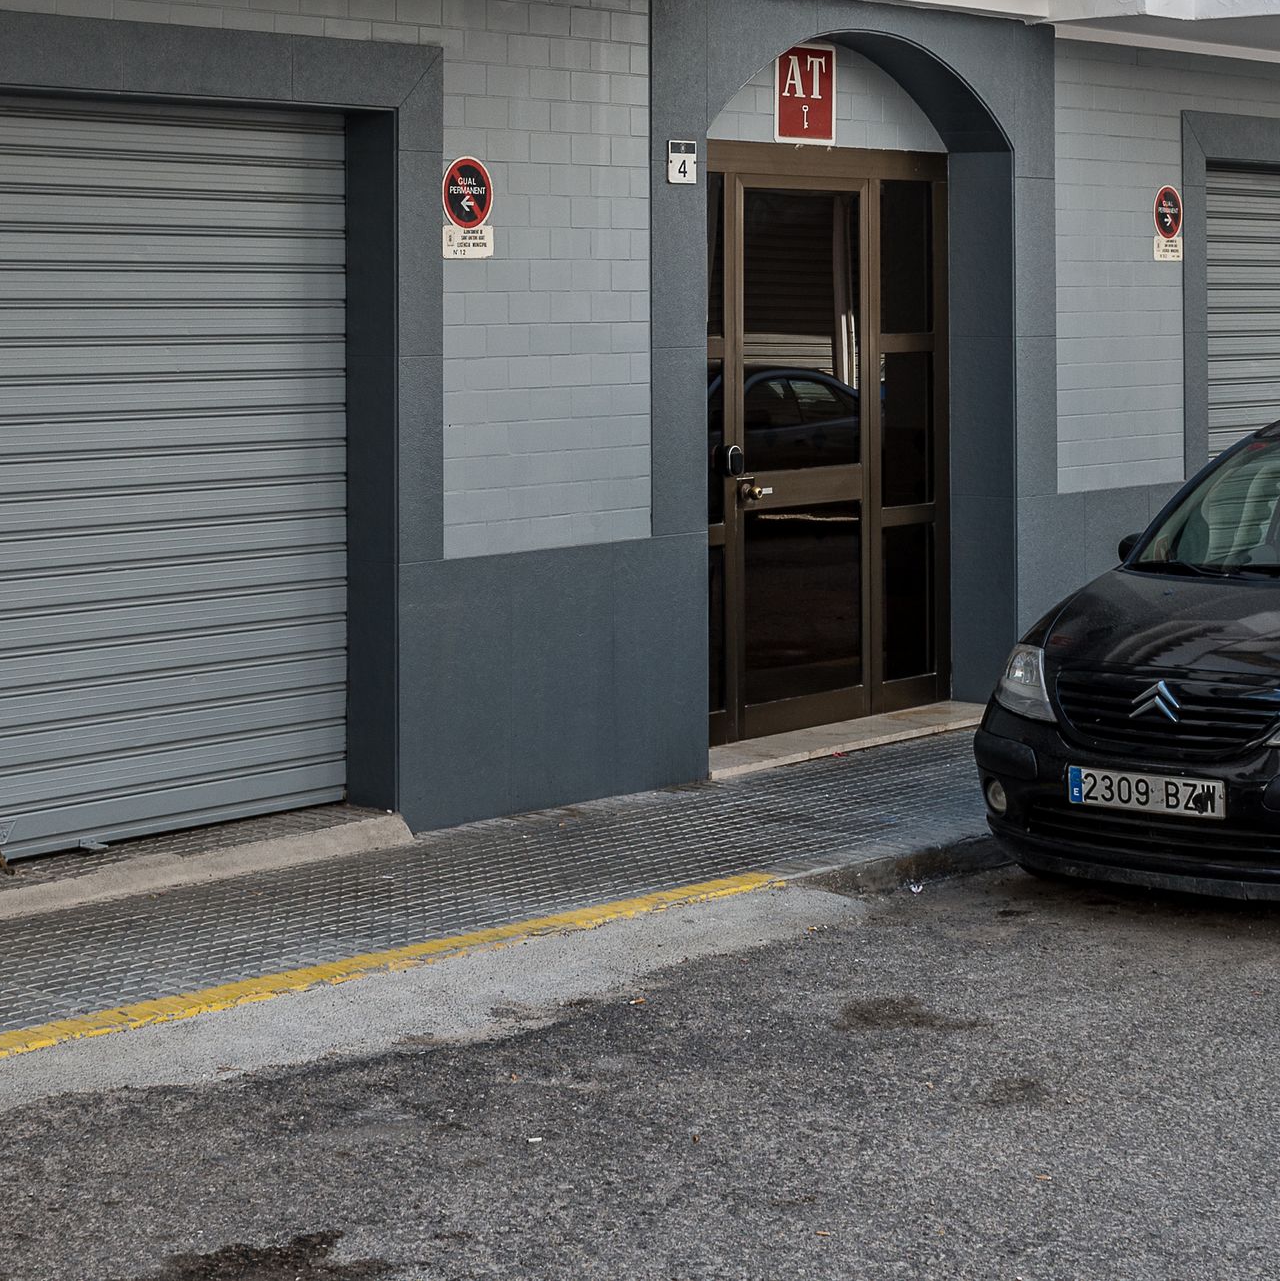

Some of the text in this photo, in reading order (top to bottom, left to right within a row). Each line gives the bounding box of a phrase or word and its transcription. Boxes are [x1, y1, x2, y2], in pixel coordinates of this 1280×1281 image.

[782, 55, 826, 99] AT
[678, 159, 688, 178] 4
[449, 185, 486, 195] PERMANENT
[458, 177, 477, 185] GUAL
[1083, 772, 1150, 806] 2309
